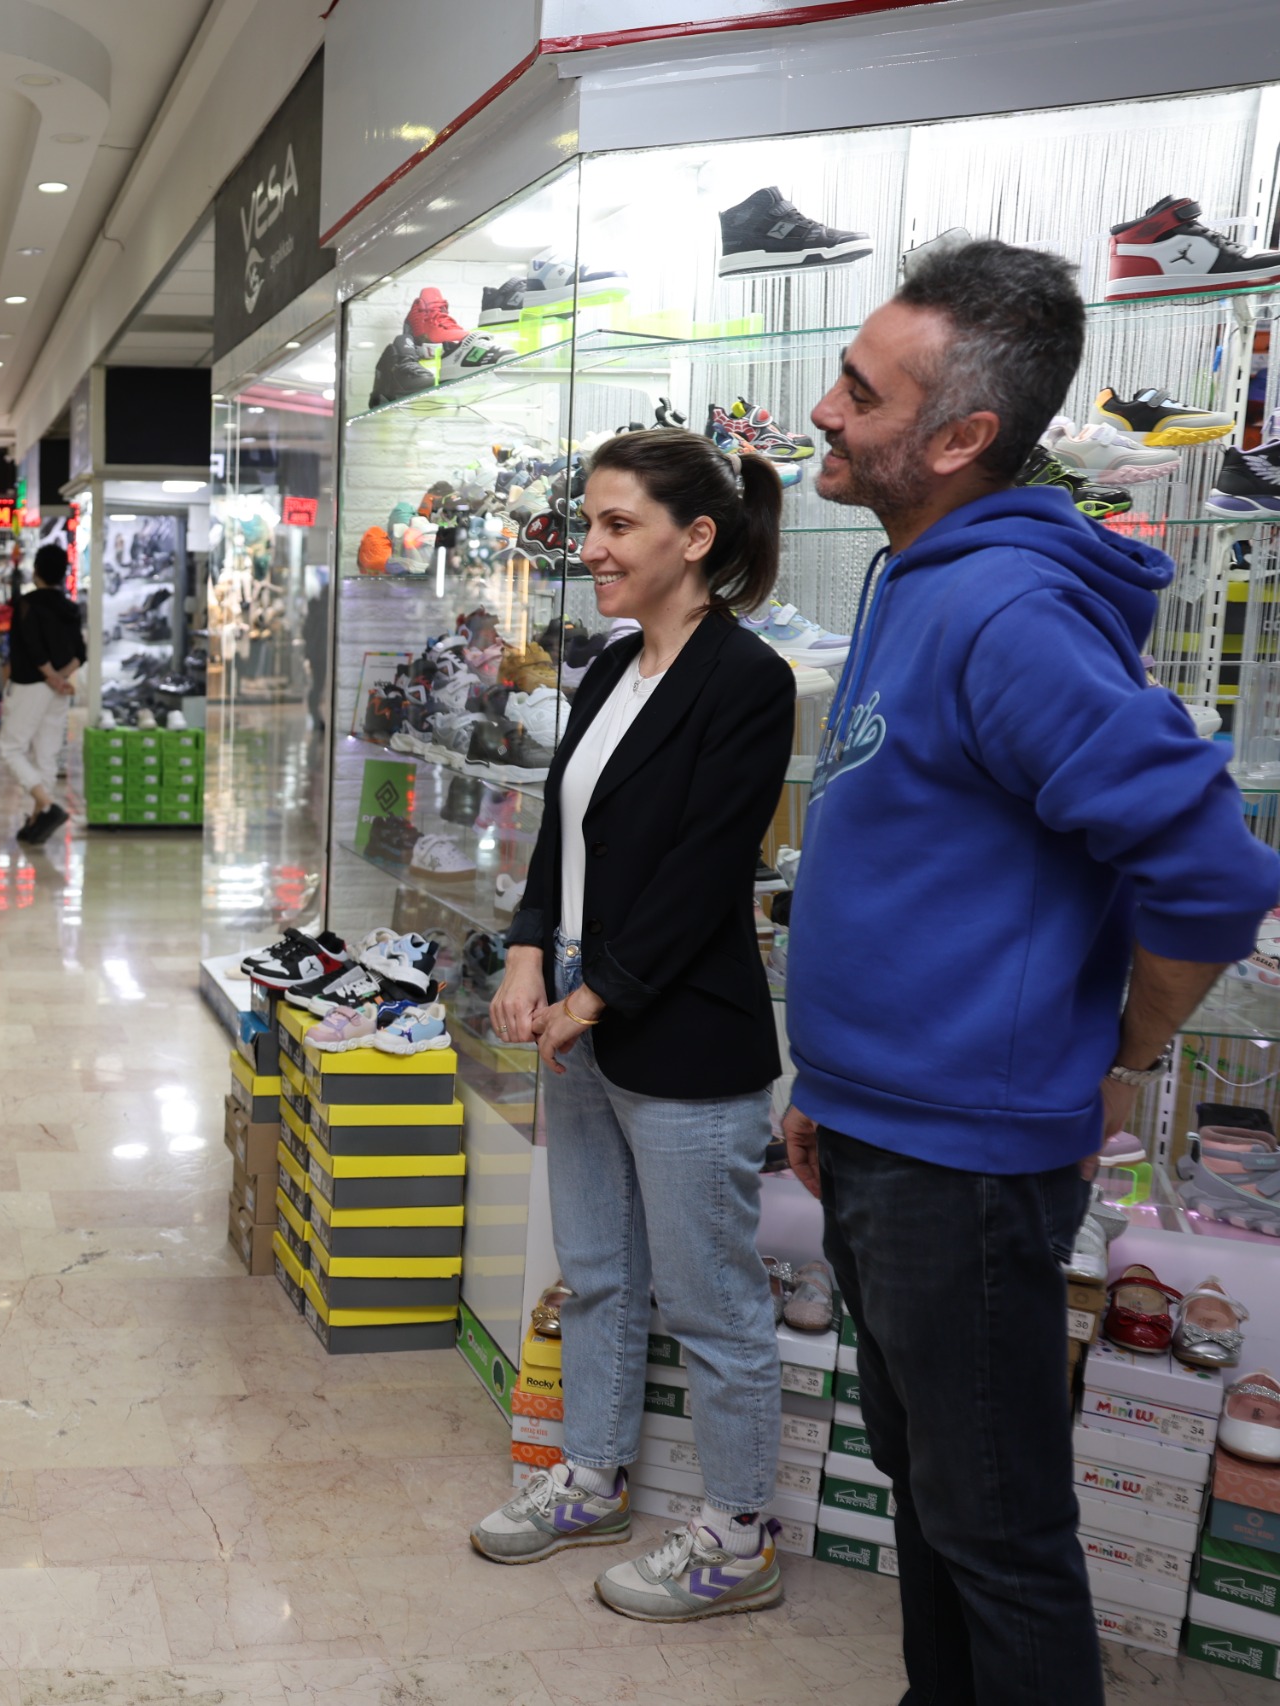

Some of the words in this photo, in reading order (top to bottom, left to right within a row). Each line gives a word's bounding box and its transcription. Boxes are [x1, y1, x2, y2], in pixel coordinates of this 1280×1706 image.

[241, 143, 298, 252] VESA
[1075, 1320, 1089, 1329] 30
[526, 1376, 555, 1390] Rocky
[806, 1378, 819, 1387] 30
[806, 1429, 819, 1438] 27
[1189, 1425, 1205, 1436] 34
[844, 1444, 872, 1455] TARCI
[799, 1475, 811, 1485] 27
[1174, 1493, 1189, 1504] 32
[690, 1504, 701, 1512] 24
[791, 1532, 804, 1541] 27
[1163, 1560, 1179, 1571] 34
[1153, 1628, 1168, 1639] 33
